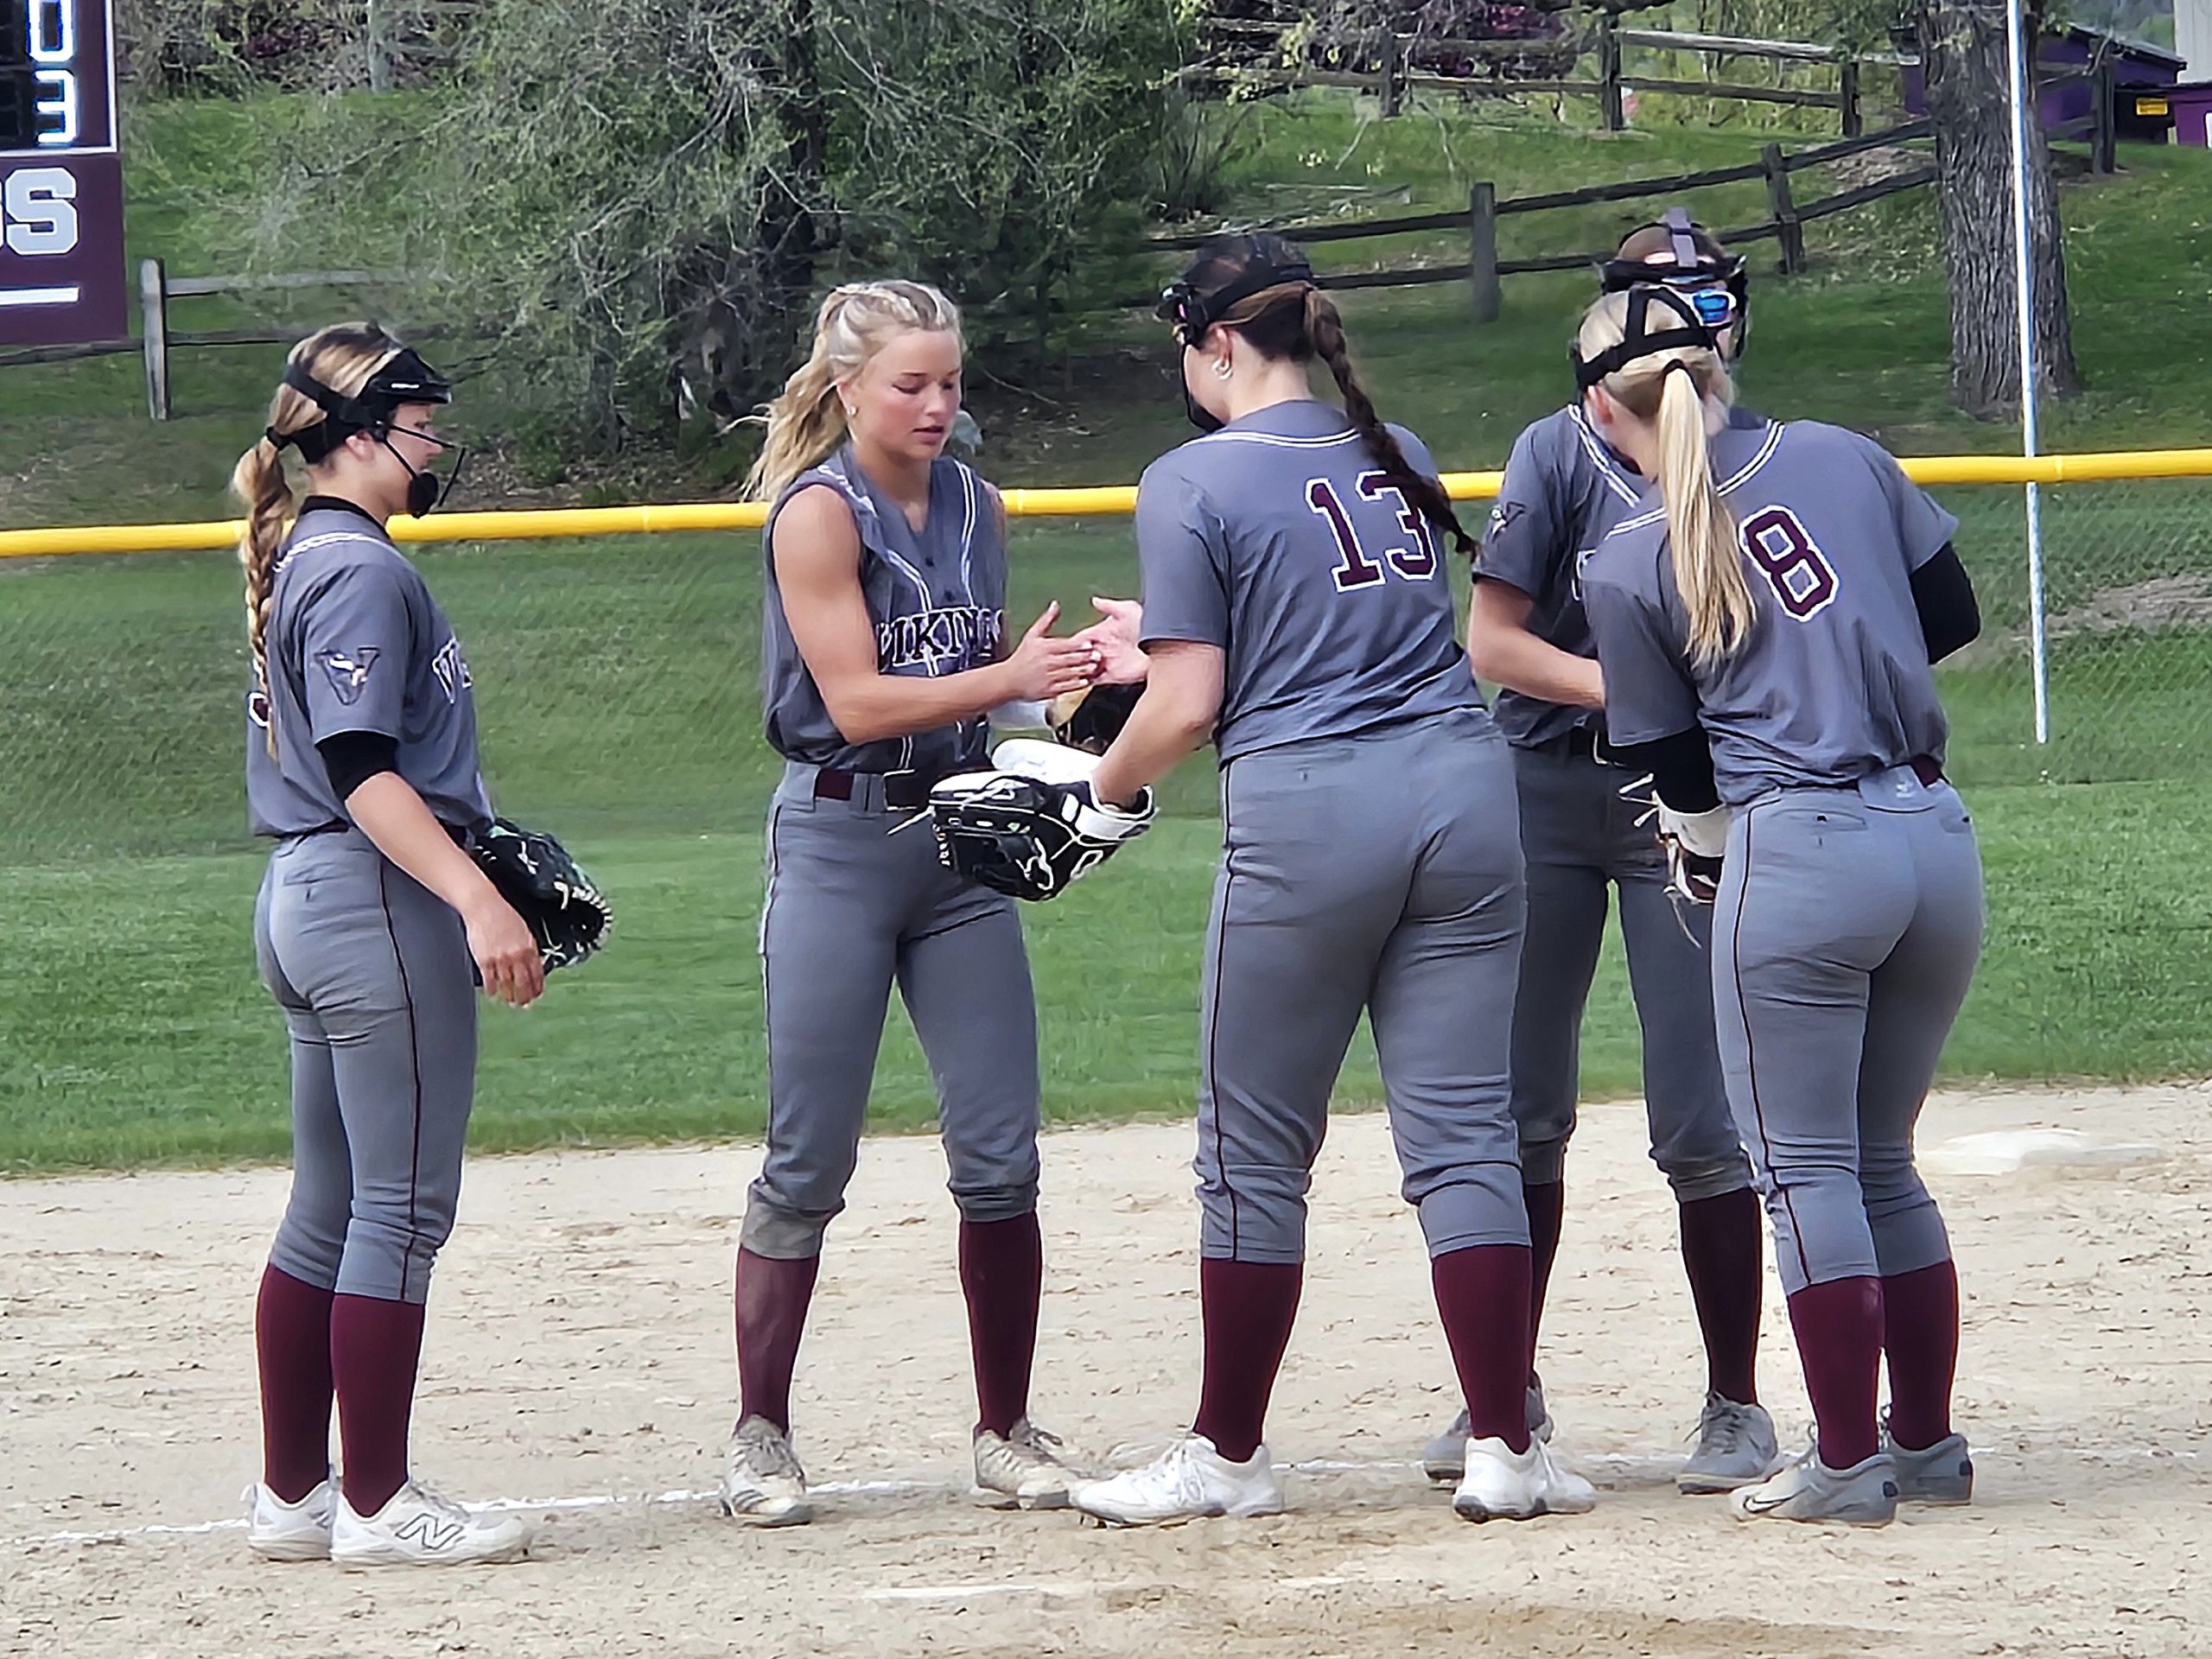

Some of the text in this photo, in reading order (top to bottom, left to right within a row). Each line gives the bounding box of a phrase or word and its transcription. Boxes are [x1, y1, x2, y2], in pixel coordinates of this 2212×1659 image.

[26, 0, 74, 63] 0
[33, 68, 78, 148] 3
[0, 167, 79, 257] S
[1305, 470, 1437, 594] 13
[1738, 504, 1840, 623] 8
